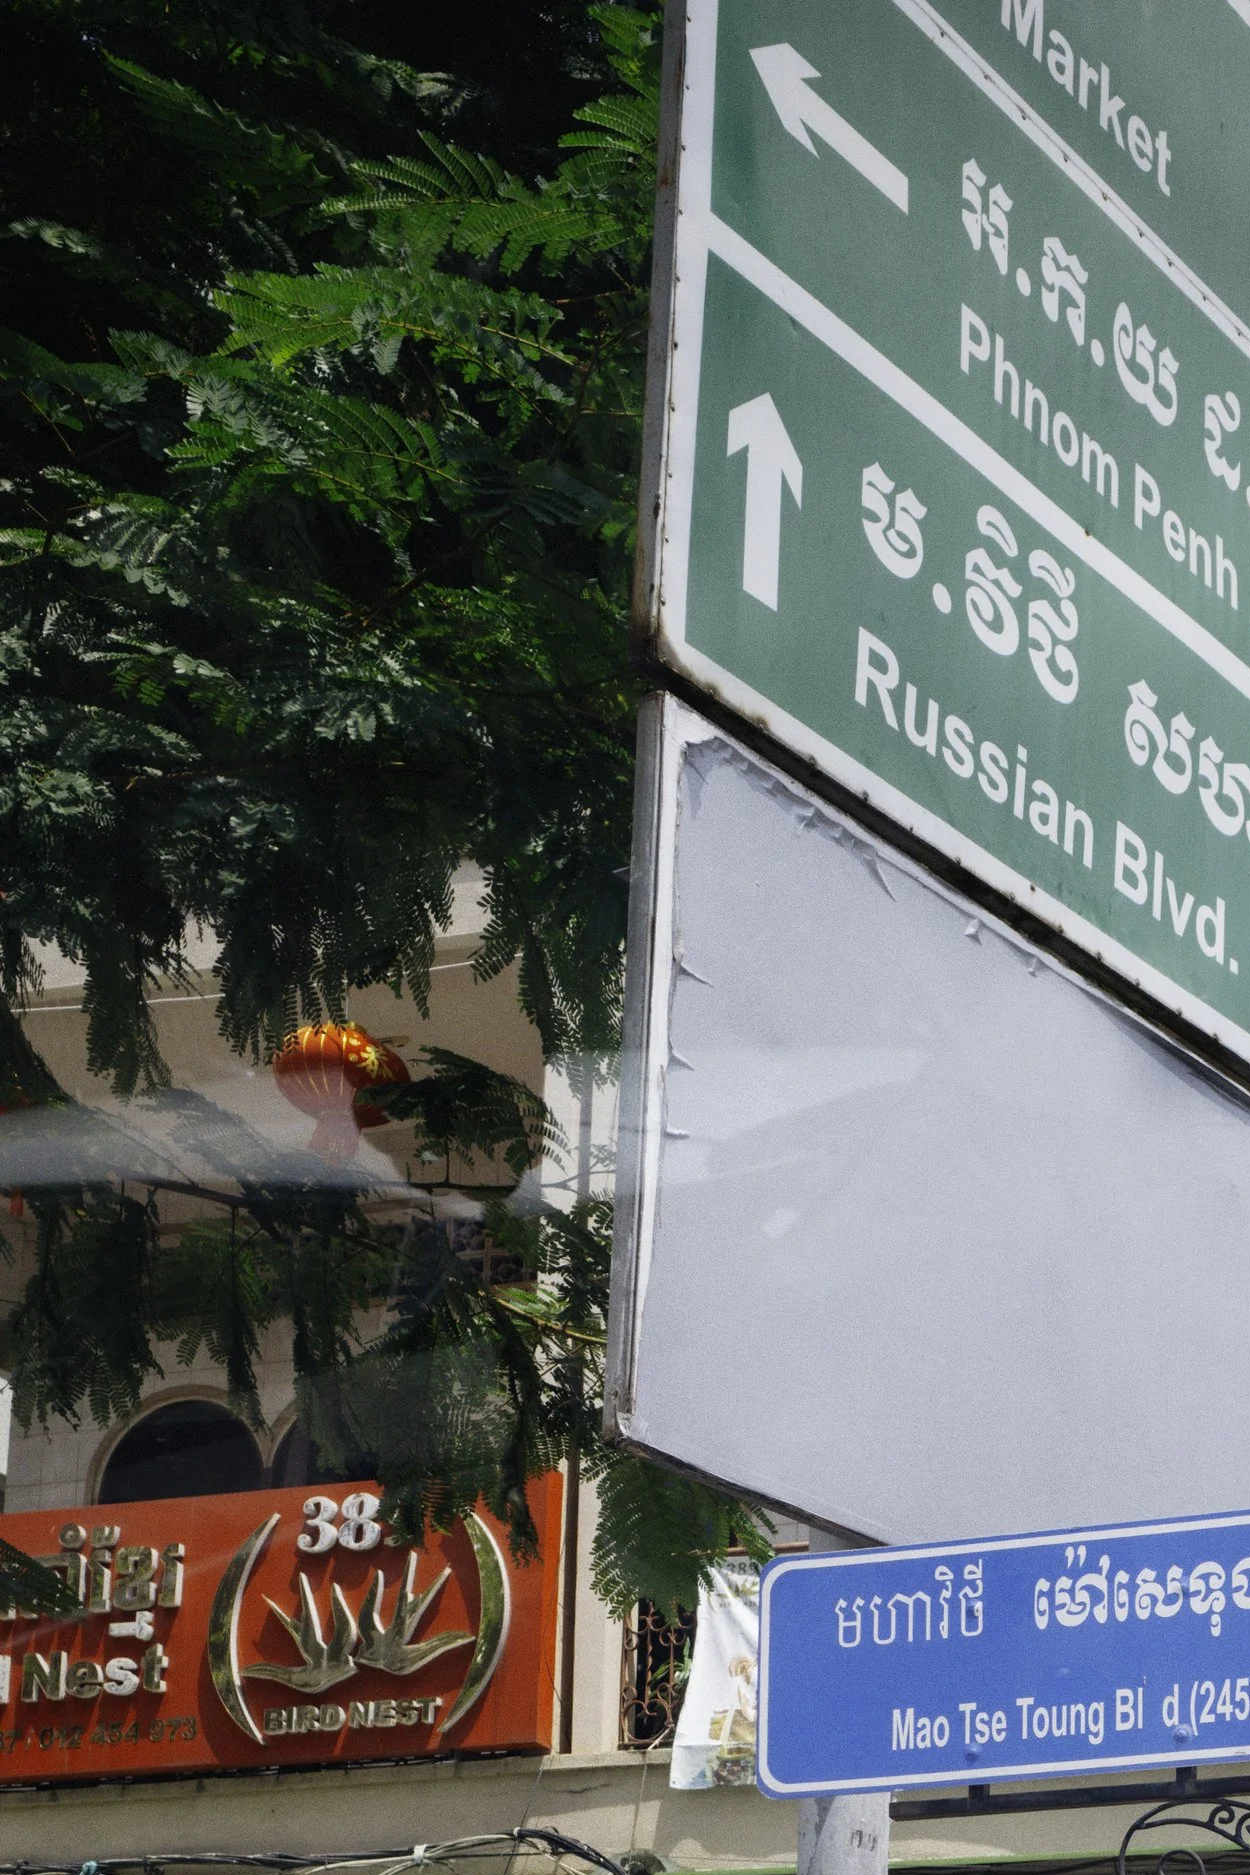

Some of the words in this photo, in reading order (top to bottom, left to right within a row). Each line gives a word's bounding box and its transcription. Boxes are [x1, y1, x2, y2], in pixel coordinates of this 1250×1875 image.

[1001, 0, 1172, 197] Market
[960, 303, 1119, 509] Phnom
[1134, 462, 1238, 611] Penh
[855, 627, 1094, 870] Russian
[1114, 819, 1239, 975] Blvd.
[297, 1492, 400, 1555] 38
[834, 1558, 984, 1648] មហាវិថី
[21, 1643, 170, 1703] Nest
[38, 1723, 84, 1750] 012
[90, 1719, 141, 1745] 454
[149, 1715, 198, 1744] 973
[263, 1704, 346, 1736] BIRD
[348, 1696, 442, 1729] NEST
[891, 1707, 950, 1751] Mao
[959, 1702, 1007, 1744] Tse
[1016, 1696, 1105, 1746] Toung
